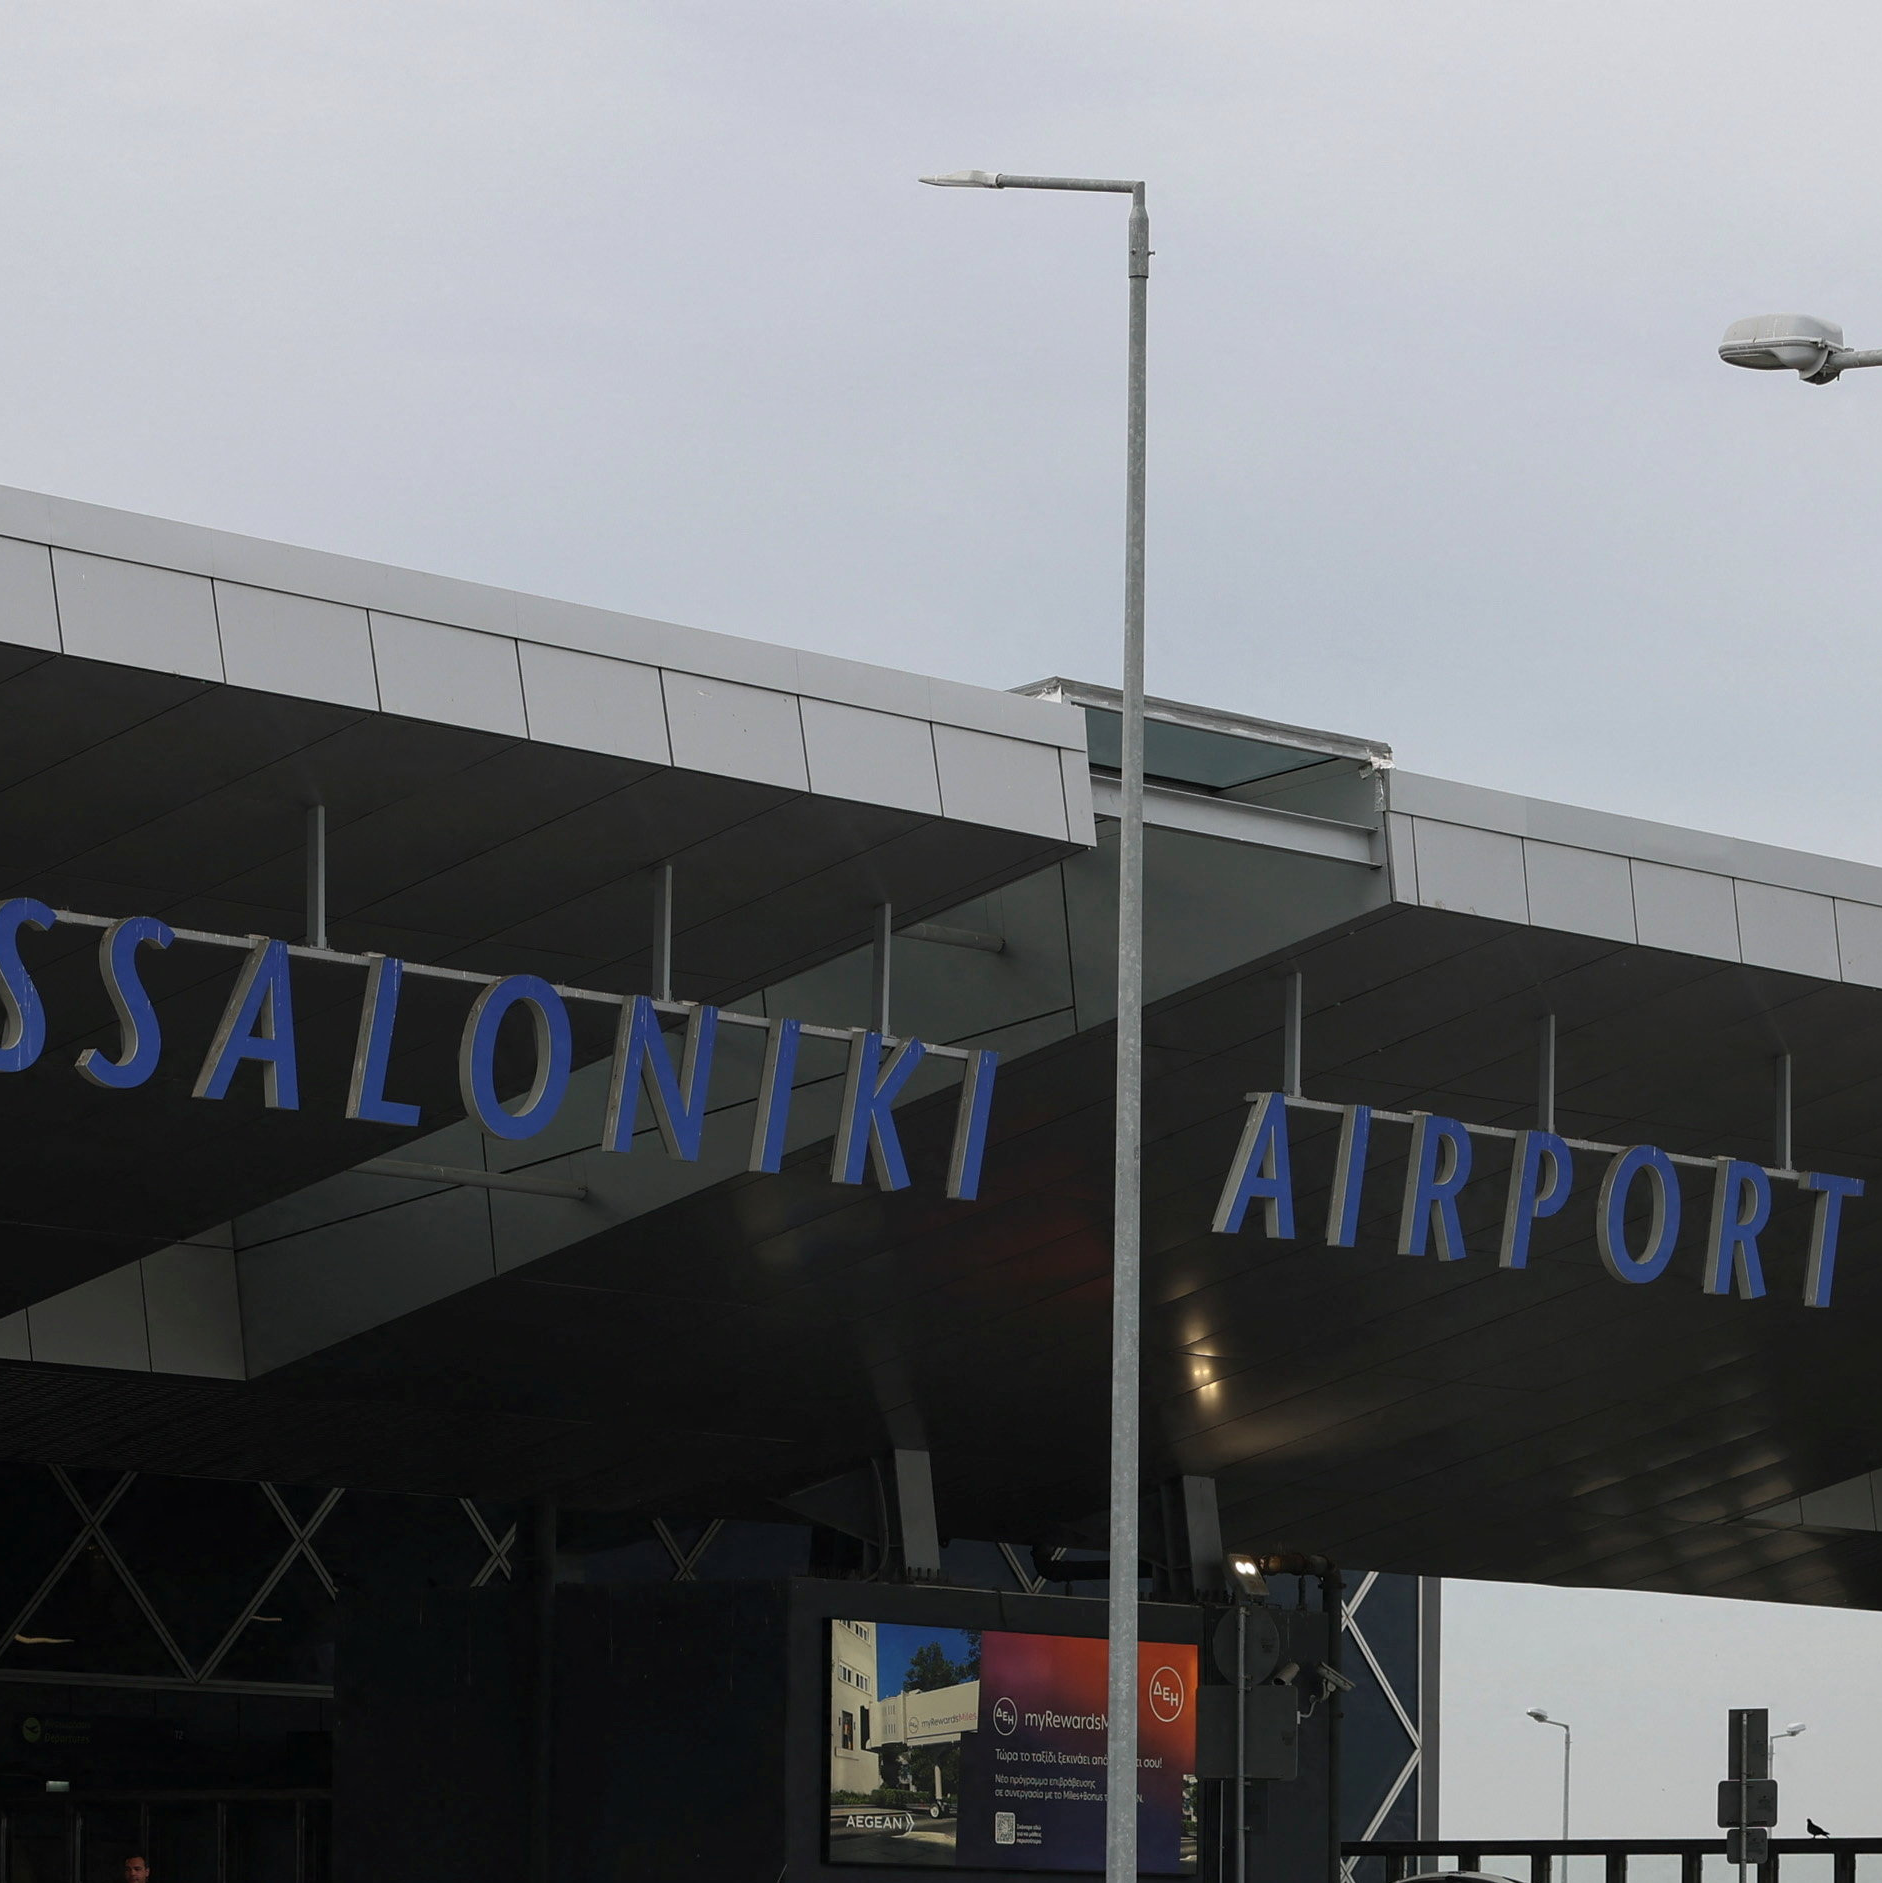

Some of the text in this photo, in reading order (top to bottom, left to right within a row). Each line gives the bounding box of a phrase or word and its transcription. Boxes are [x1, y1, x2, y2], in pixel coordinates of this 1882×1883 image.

[1212, 1092, 1864, 1308] AIRPORT
[1153, 1681, 1179, 1707] ΔΕΗ
[996, 1707, 1109, 1731] ΔΕΗ myRewardsM
[995, 1749, 1018, 1762] Τώρα
[1020, 1752, 1030, 1762] το
[1031, 1751, 1057, 1765] ταξίδι
[1058, 1752, 1091, 1766] ξεκινάει
[1092, 1754, 1108, 1766] από
[1143, 1757, 1163, 1769] σου!
[846, 1815, 903, 1830] AEGEAN
